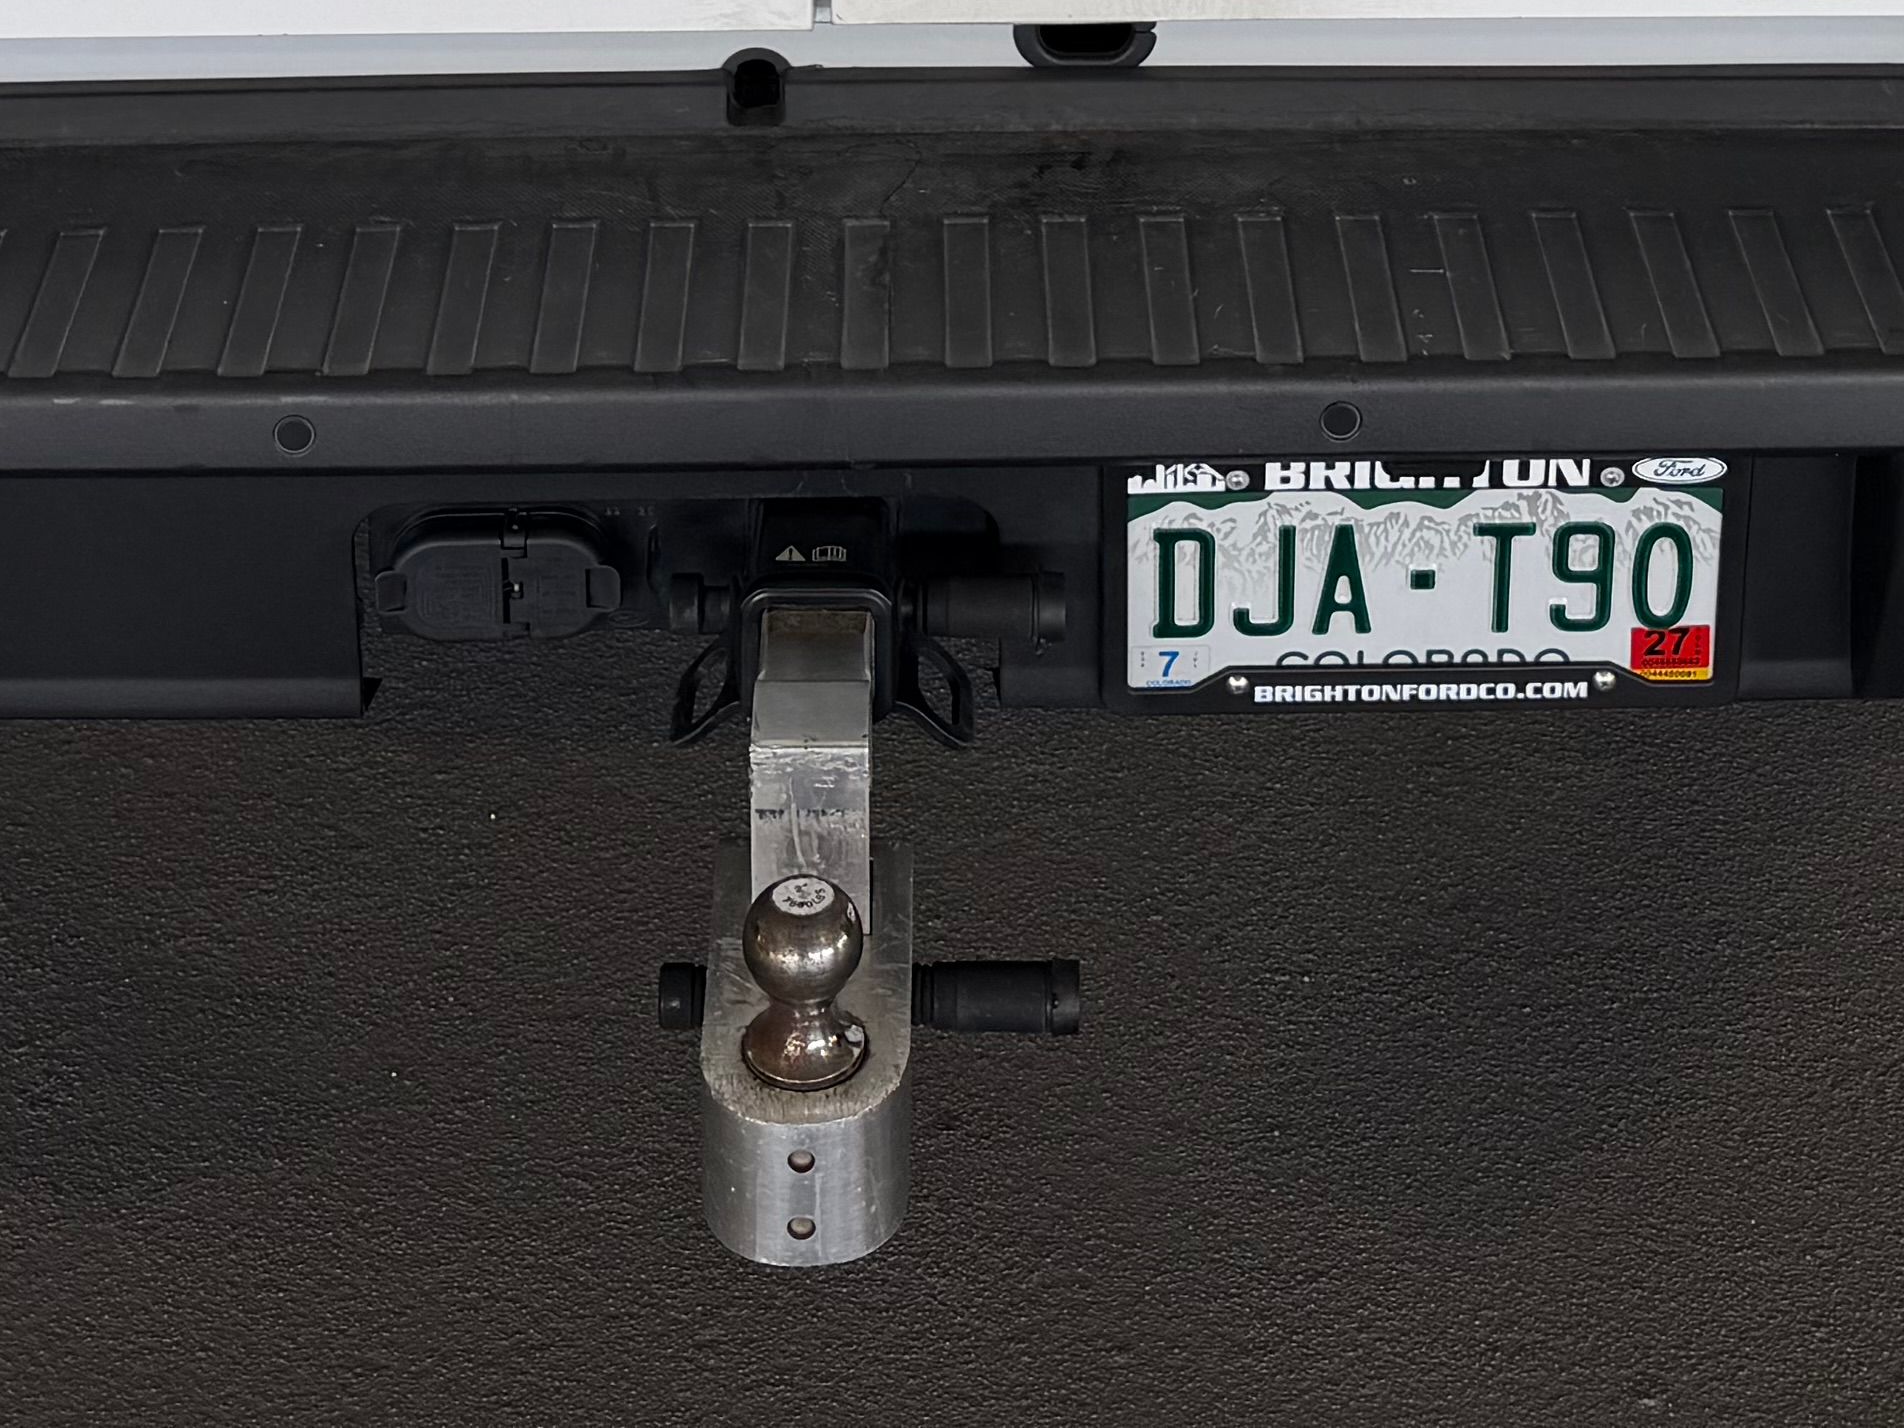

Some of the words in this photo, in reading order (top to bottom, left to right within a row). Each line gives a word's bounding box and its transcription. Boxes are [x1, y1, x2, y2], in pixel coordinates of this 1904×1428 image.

[1653, 458, 1706, 477] Ford
[1643, 627, 1691, 656] 27
[1158, 650, 1180, 678] 7
[1253, 680, 1589, 704] BRIGHTONFORDCO.COM
